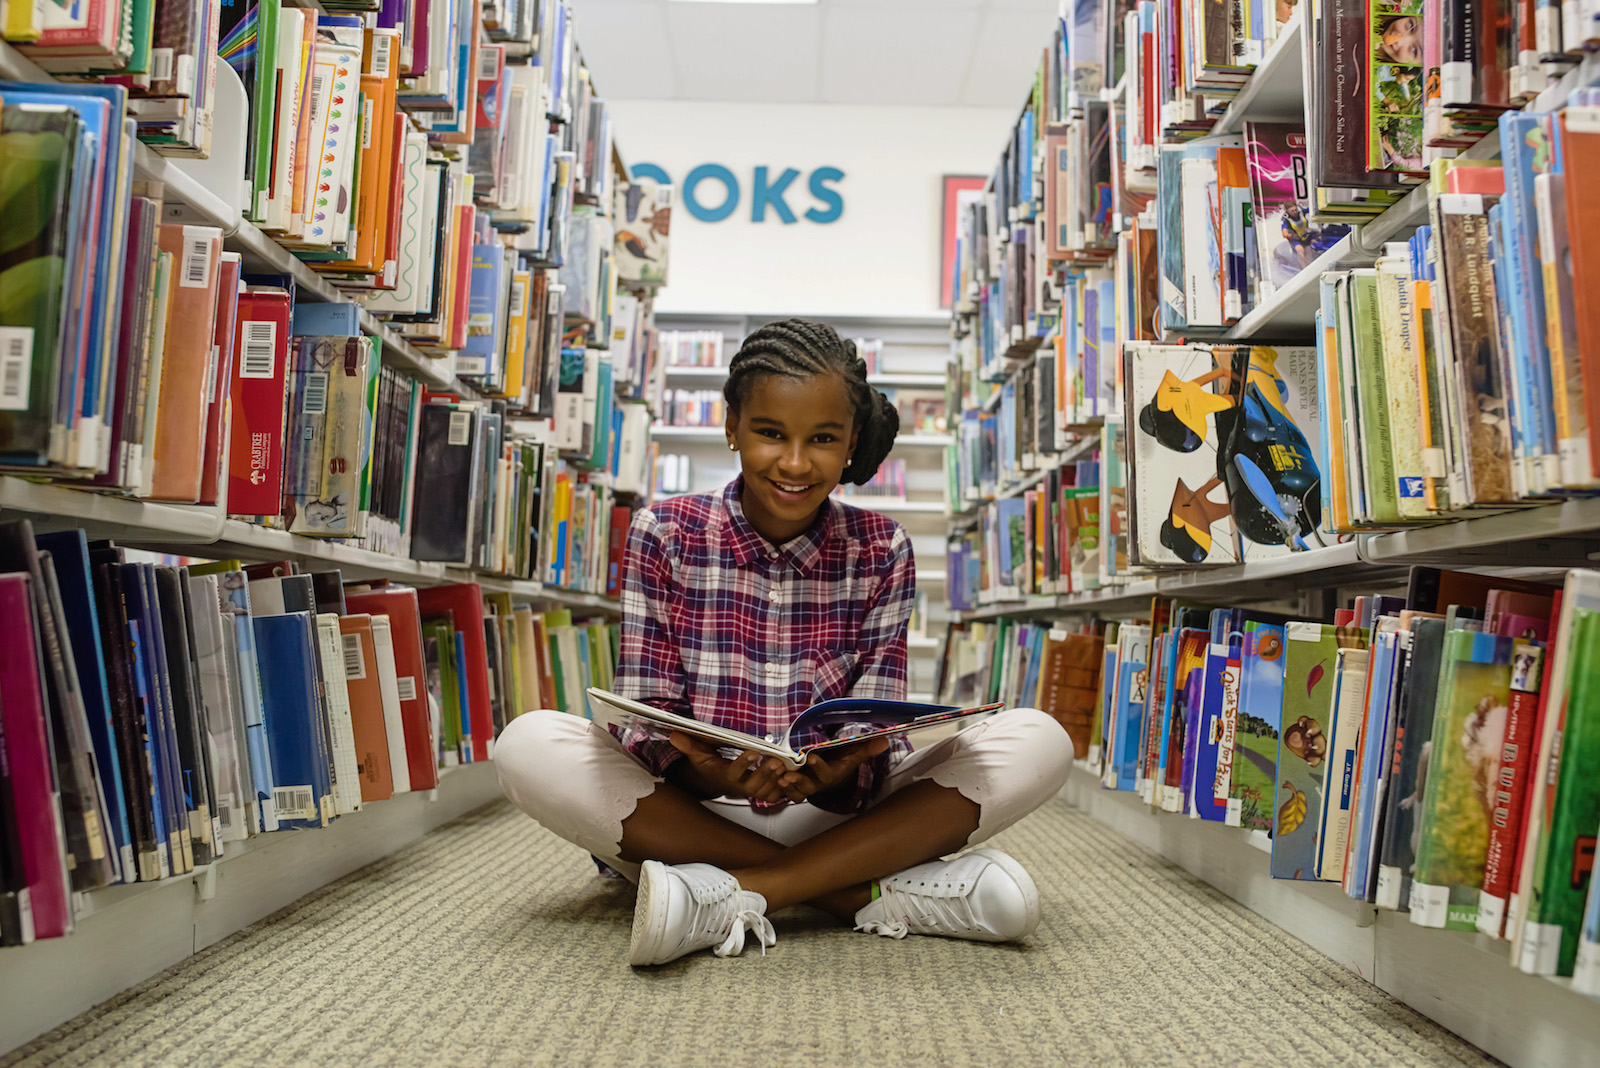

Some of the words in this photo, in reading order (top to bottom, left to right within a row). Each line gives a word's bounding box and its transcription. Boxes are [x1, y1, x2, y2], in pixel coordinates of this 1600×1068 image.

[1336, 8, 1344, 37] Messner
[1336, 38, 1344, 53] with
[1335, 64, 1344, 73] by
[292, 82, 300, 127] MATTER
[1335, 74, 1345, 115] Christopher
[1336, 116, 1345, 133] Silas
[1336, 135, 1345, 153] Neal
[287, 140, 295, 188] ENERGY
[629, 163, 846, 224] OKS
[1463, 214, 1476, 233] vid
[1465, 237, 1476, 249] R.
[1368, 285, 1379, 321] Illustrated
[1393, 275, 1409, 309] Judith
[1466, 253, 1483, 318] Lundquist
[1371, 322, 1380, 338] with
[1399, 312, 1411, 352] Draper
[1289, 350, 1297, 377] MADE
[1298, 350, 1307, 385] PLANES
[1307, 350, 1316, 377] MOST
[1299, 386, 1307, 410] EVER
[1308, 378, 1318, 422] UNUSUAL
[1378, 412, 1387, 427] and
[250, 432, 262, 470] CRABTREE
[1381, 460, 1394, 503] photographs
[1219, 670, 1236, 706] Quick
[1346, 679, 1362, 728] Grooming
[1225, 707, 1238, 743] Starts
[1221, 745, 1233, 761] for
[1333, 816, 1348, 871] Obedience
